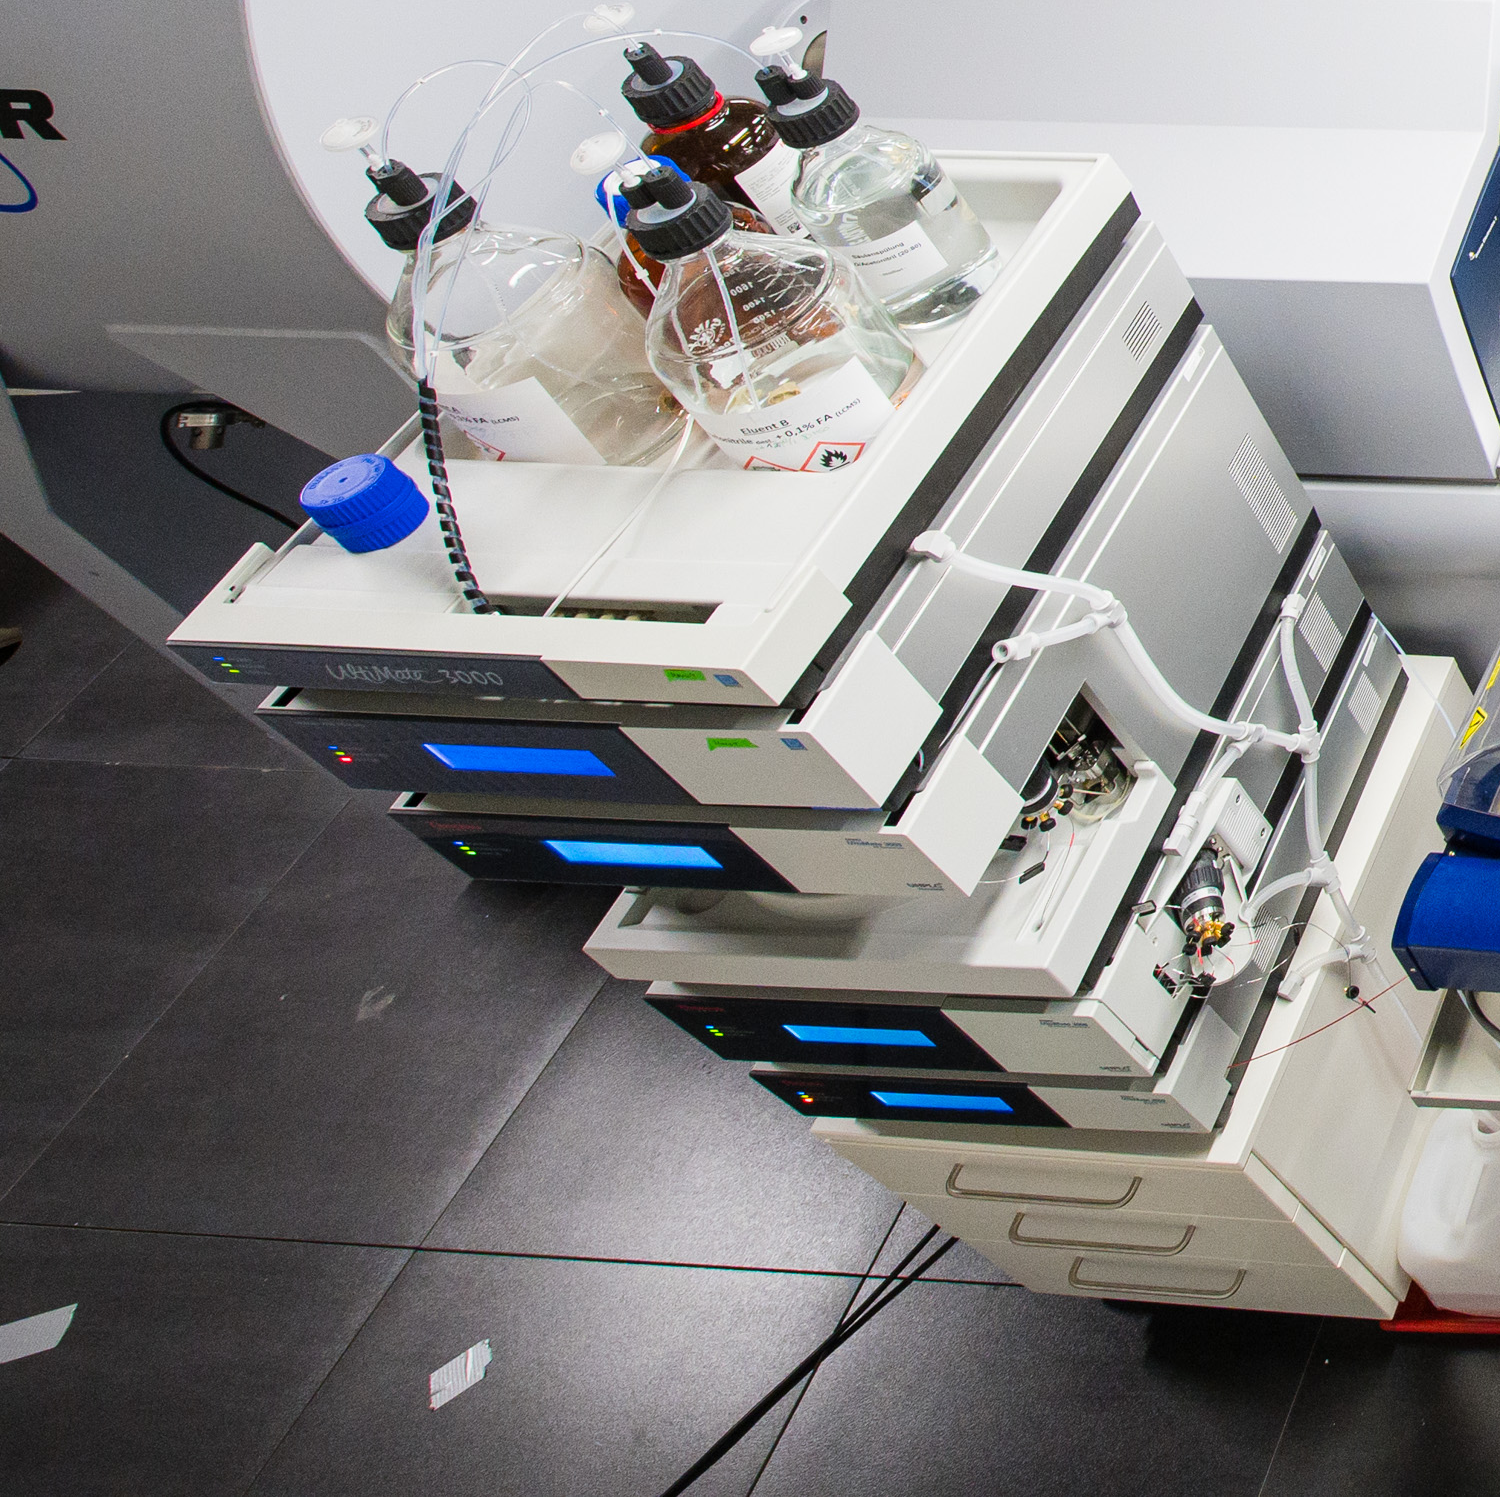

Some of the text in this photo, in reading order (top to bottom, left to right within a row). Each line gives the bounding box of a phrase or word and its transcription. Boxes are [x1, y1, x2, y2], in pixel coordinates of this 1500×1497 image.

[784, 422, 815, 438] 0,1%
[815, 413, 834, 426] FA
[835, 397, 862, 417] (LCMS)
[740, 419, 790, 435] Eluent B
[437, 668, 505, 686] 3000
